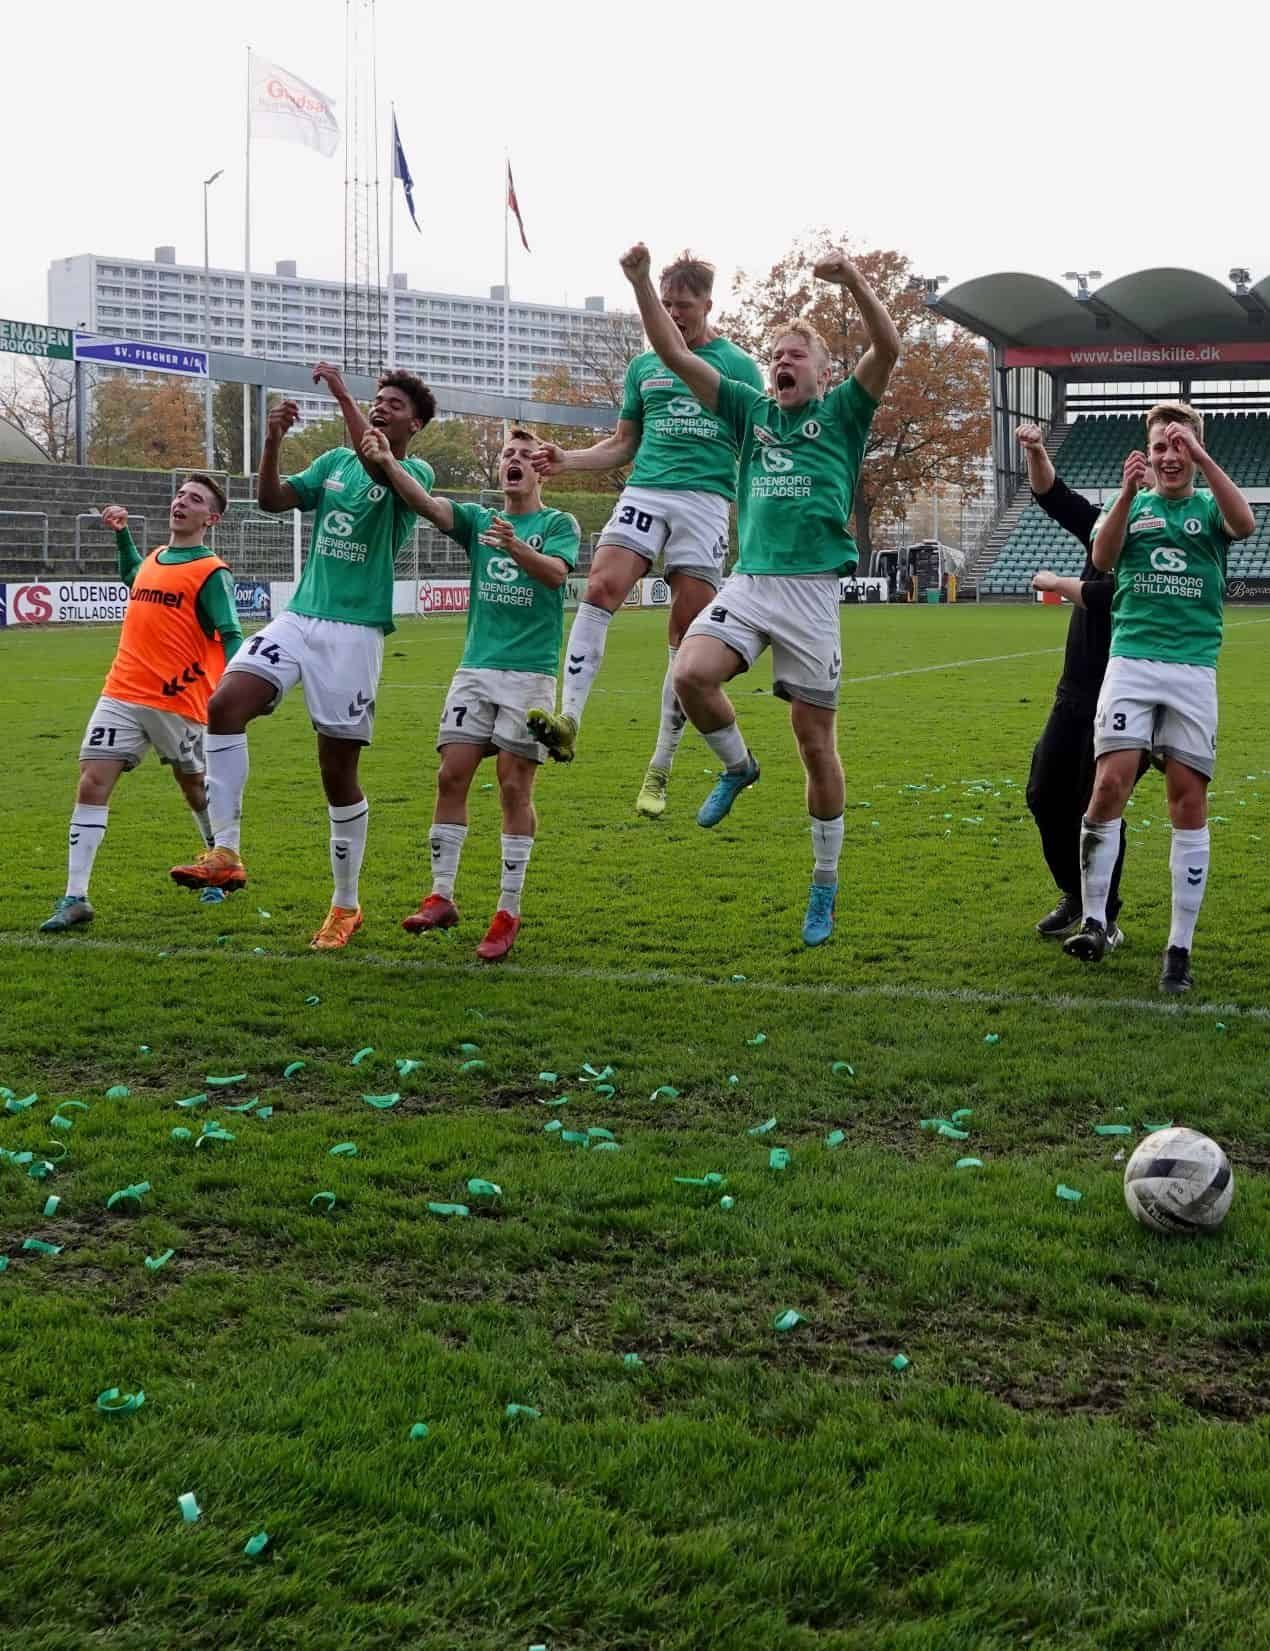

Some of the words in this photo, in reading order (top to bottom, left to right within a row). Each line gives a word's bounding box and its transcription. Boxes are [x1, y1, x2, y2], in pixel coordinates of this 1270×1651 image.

[136, 349, 178, 364] FISCHER
[1070, 346, 1222, 363] www.bellaskilte.dk
[619, 506, 653, 533] 30
[1134, 573, 1204, 588] OLDENBORG
[60, 586, 129, 602] OLDENBO
[130, 588, 184, 609] ummel
[1133, 583, 1202, 598] STILLADSER
[433, 591, 470, 608] BAUH
[248, 636, 280, 664] 14
[453, 706, 467, 727] 7
[1113, 713, 1127, 731] 3
[90, 728, 116, 746] 21
